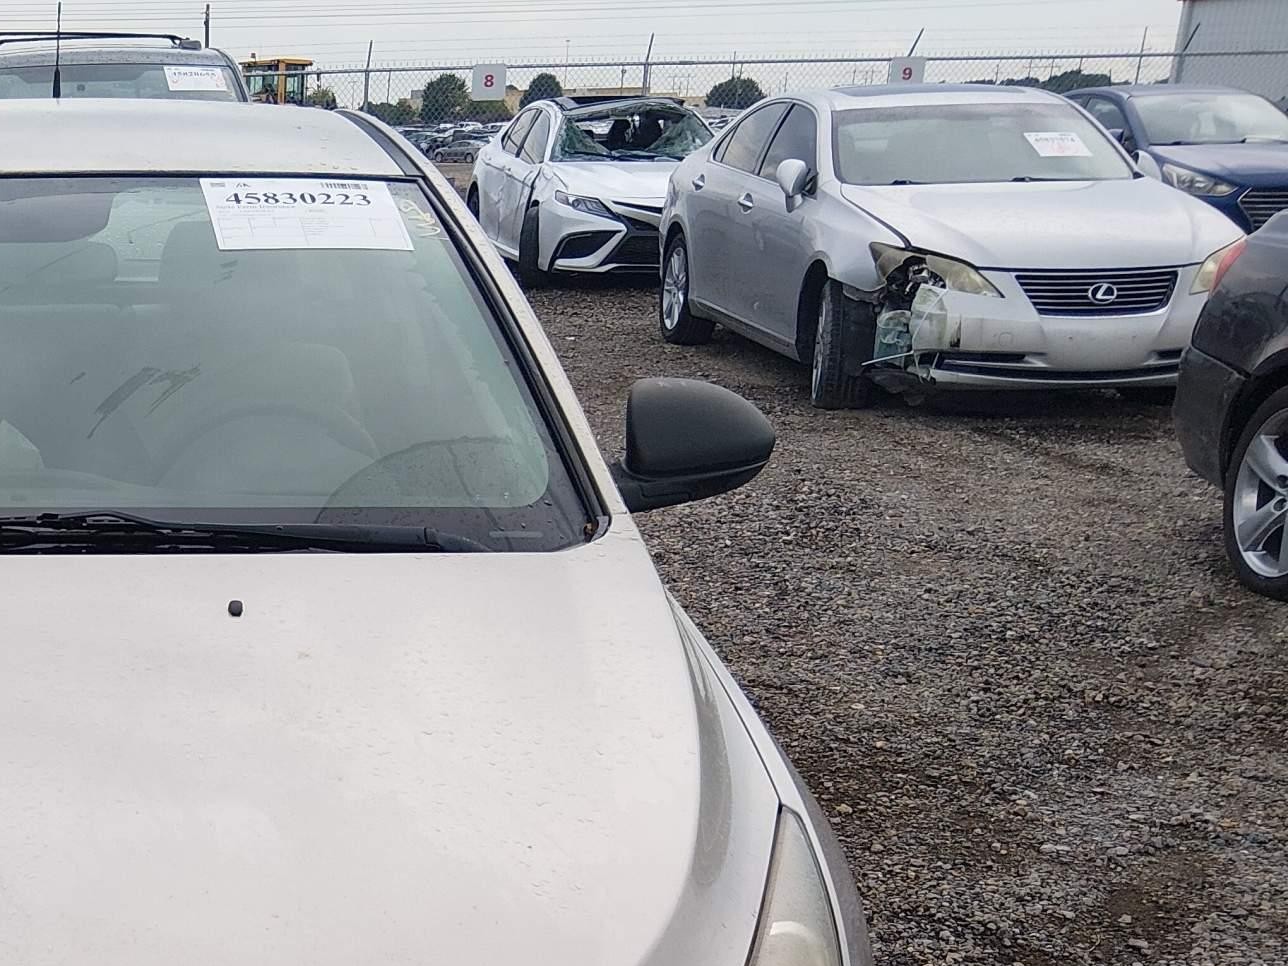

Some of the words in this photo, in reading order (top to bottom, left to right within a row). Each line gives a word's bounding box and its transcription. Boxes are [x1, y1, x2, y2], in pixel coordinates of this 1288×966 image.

[902, 67, 912, 80] 9
[484, 74, 494, 87] 8
[225, 192, 372, 207] 45830223
